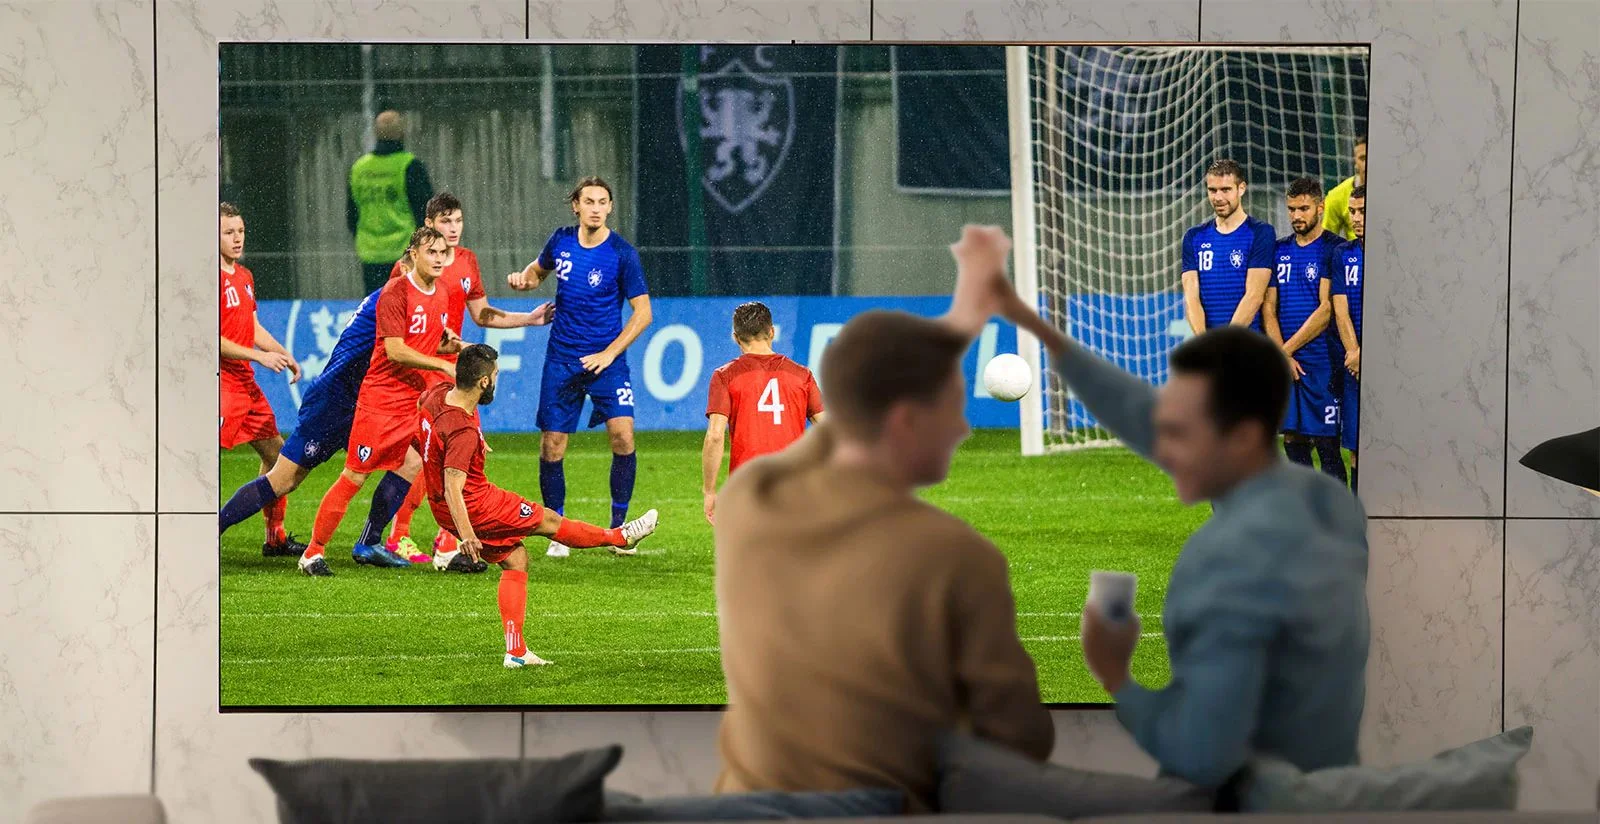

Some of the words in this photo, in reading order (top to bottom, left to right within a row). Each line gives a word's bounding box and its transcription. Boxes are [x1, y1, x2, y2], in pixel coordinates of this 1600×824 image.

[555, 258, 573, 281] 22
[1198, 250, 1213, 271] 18
[1277, 263, 1292, 284] 21
[1345, 265, 1359, 286] 14
[224, 286, 240, 309] 10
[409, 313, 427, 334] 21
[757, 377, 785, 425] 4
